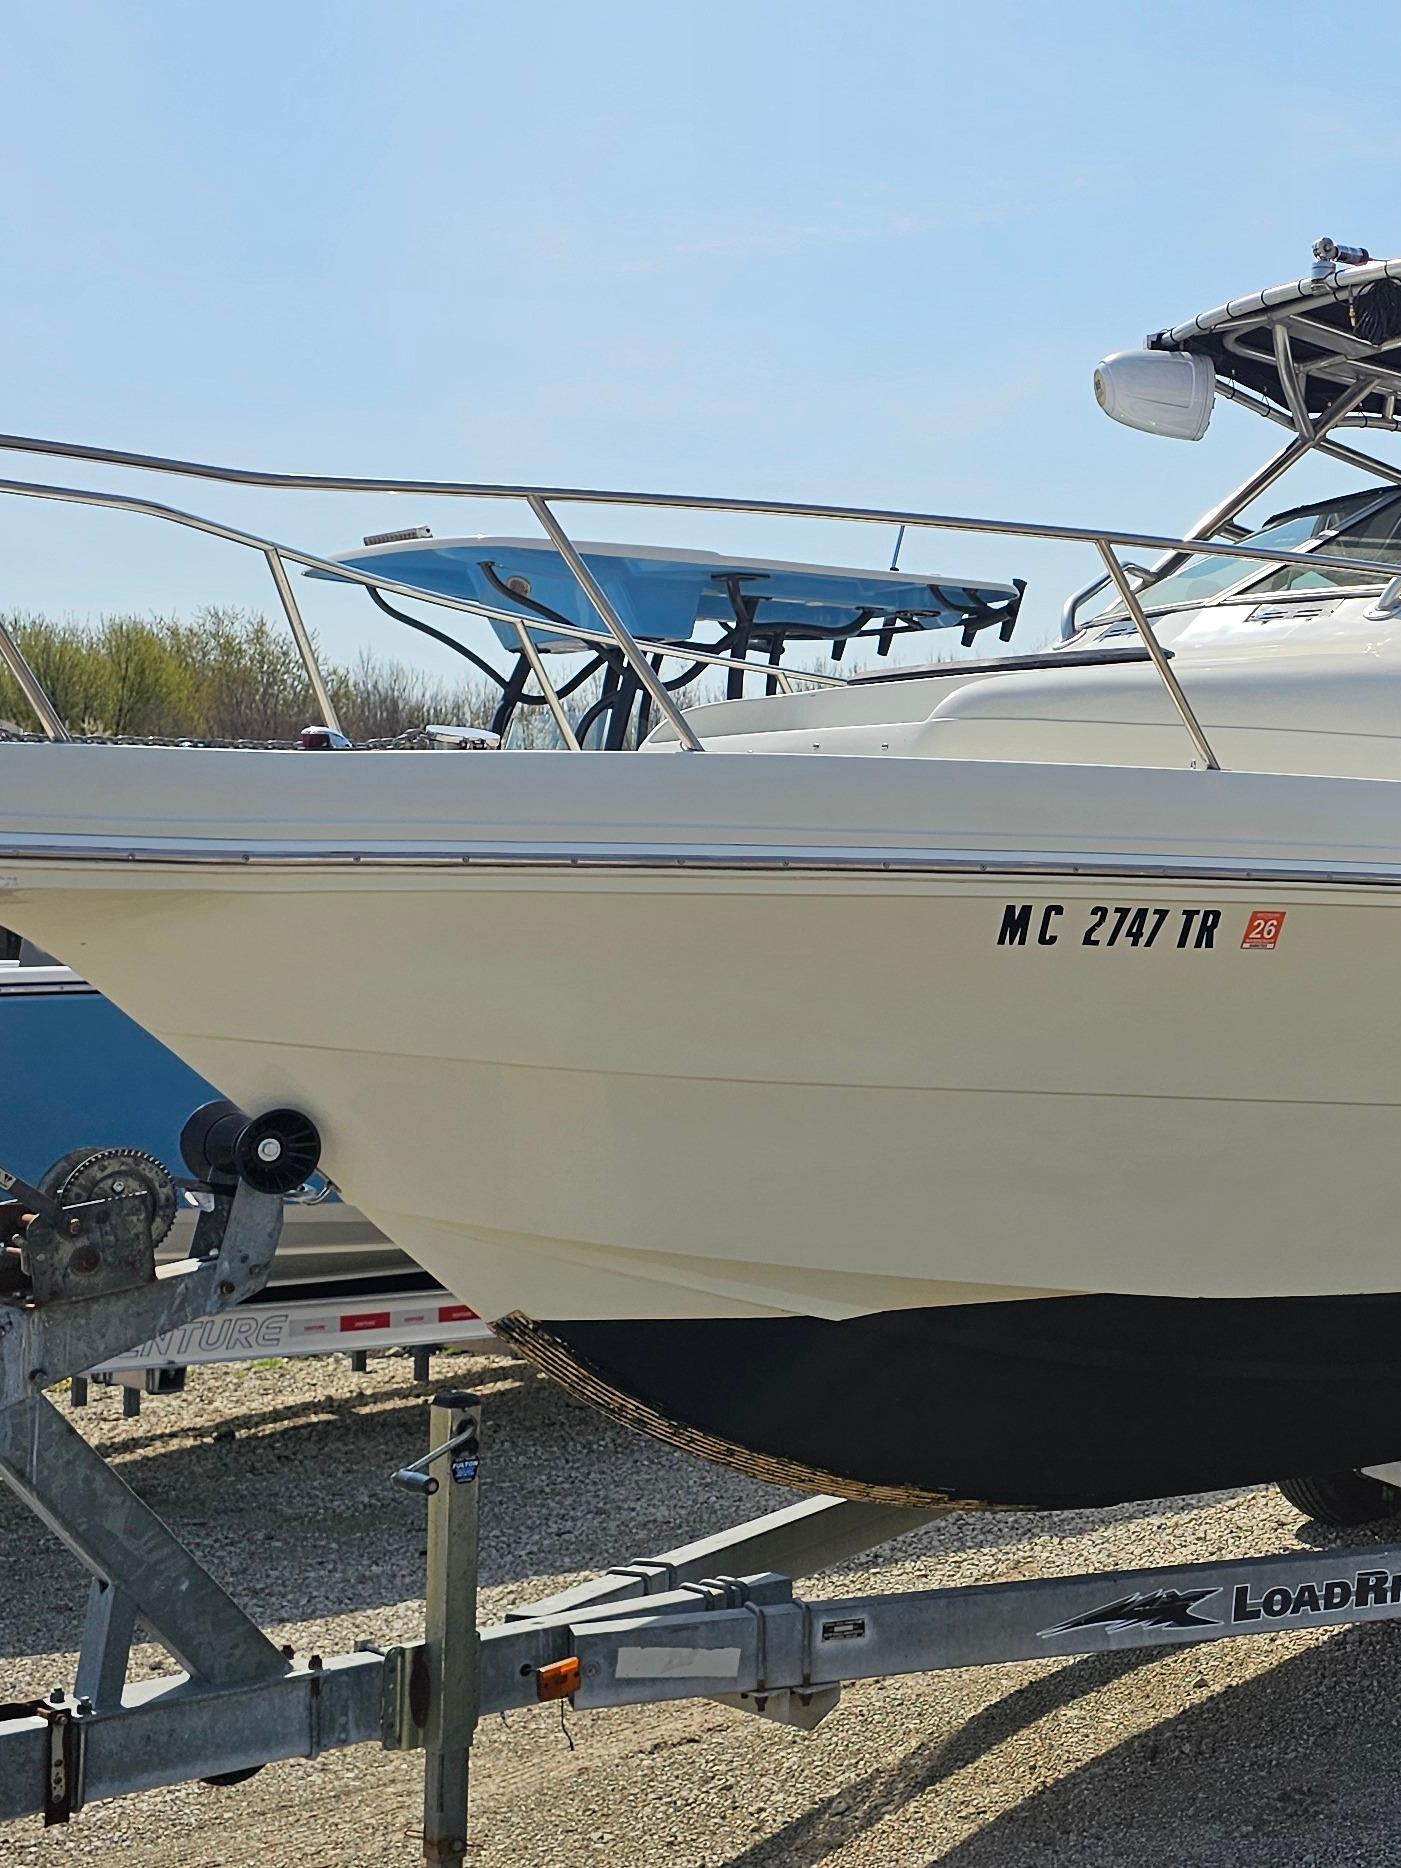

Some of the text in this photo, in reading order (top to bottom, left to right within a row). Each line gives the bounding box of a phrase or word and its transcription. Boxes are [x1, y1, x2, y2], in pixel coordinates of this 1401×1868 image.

[1081, 906, 1170, 947] 2747
[1176, 909, 1221, 949] TR
[1249, 919, 1278, 939] 26
[119, 1314, 288, 1359] NTURE
